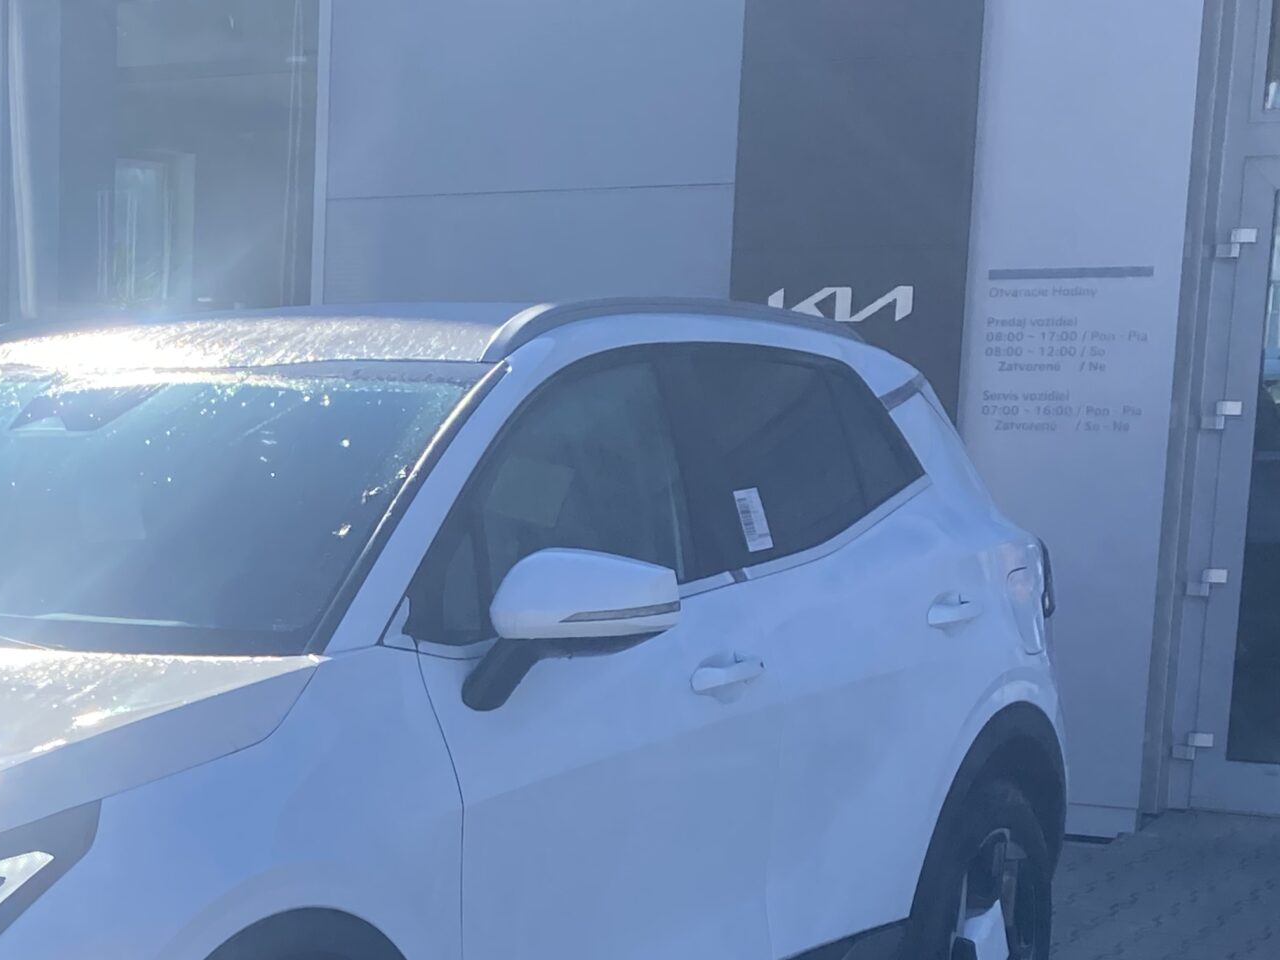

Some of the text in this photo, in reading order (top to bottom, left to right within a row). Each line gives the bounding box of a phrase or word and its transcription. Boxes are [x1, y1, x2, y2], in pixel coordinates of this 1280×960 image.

[986, 316, 1027, 329] Predaj
[985, 331, 1025, 342] 08:00
[1041, 330, 1078, 342] 17:00
[1090, 330, 1116, 341] Pon
[1128, 330, 1148, 341] Pia
[984, 346, 1023, 357] 08:00
[1040, 346, 1077, 357] 12:00
[1090, 346, 1106, 357] So
[1089, 361, 1106, 372] Ne
[982, 389, 1019, 401] Servis
[981, 405, 1020, 416] 07:00
[1035, 405, 1073, 416] 16:00
[1086, 405, 1110, 416] Pon
[1122, 405, 1143, 416] Pia
